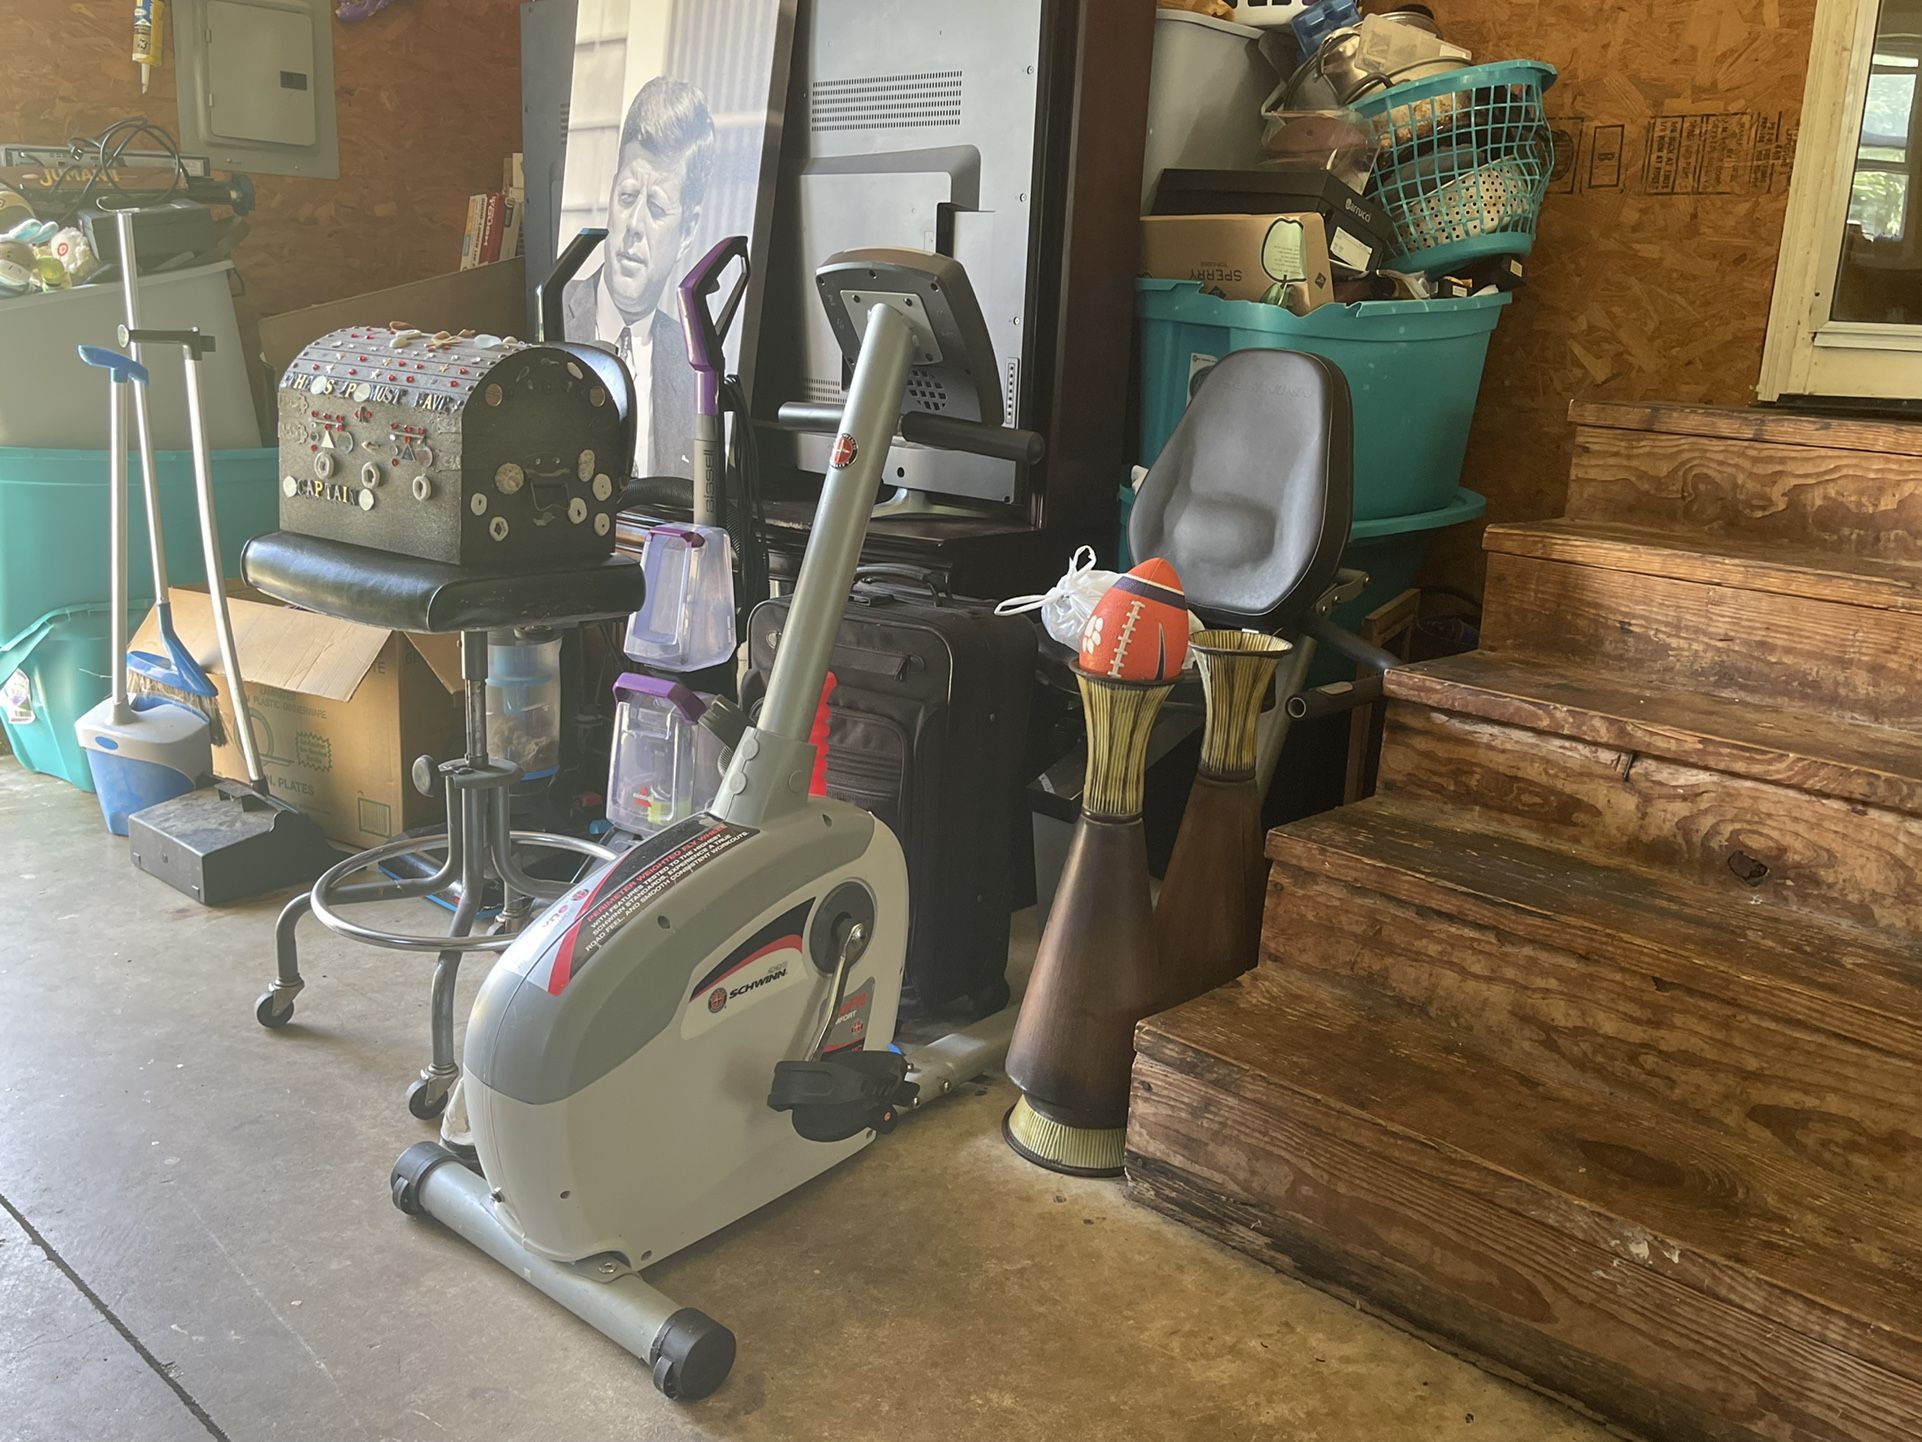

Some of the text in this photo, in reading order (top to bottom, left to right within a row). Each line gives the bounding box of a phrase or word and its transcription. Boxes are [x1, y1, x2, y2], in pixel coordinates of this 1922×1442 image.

[1190, 269, 1242, 281] SPERRY
[278, 778, 315, 796] PLATES
[585, 931, 606, 952] ROAD
[625, 902, 641, 916] AND
[640, 879, 671, 904] SMOOTH
[670, 852, 711, 881] CONSISTENT
[587, 880, 637, 922] PERIMETER
[636, 849, 682, 882] WEIGHTED
[590, 834, 722, 928] WITH FEATURES TESTED TO THE HIGHEST
[592, 905, 626, 936] SCHWINN
[668, 848, 709, 876] EXPERIENCE
[715, 834, 733, 847] TRUE
[728, 968, 787, 1000] SCHWINN
